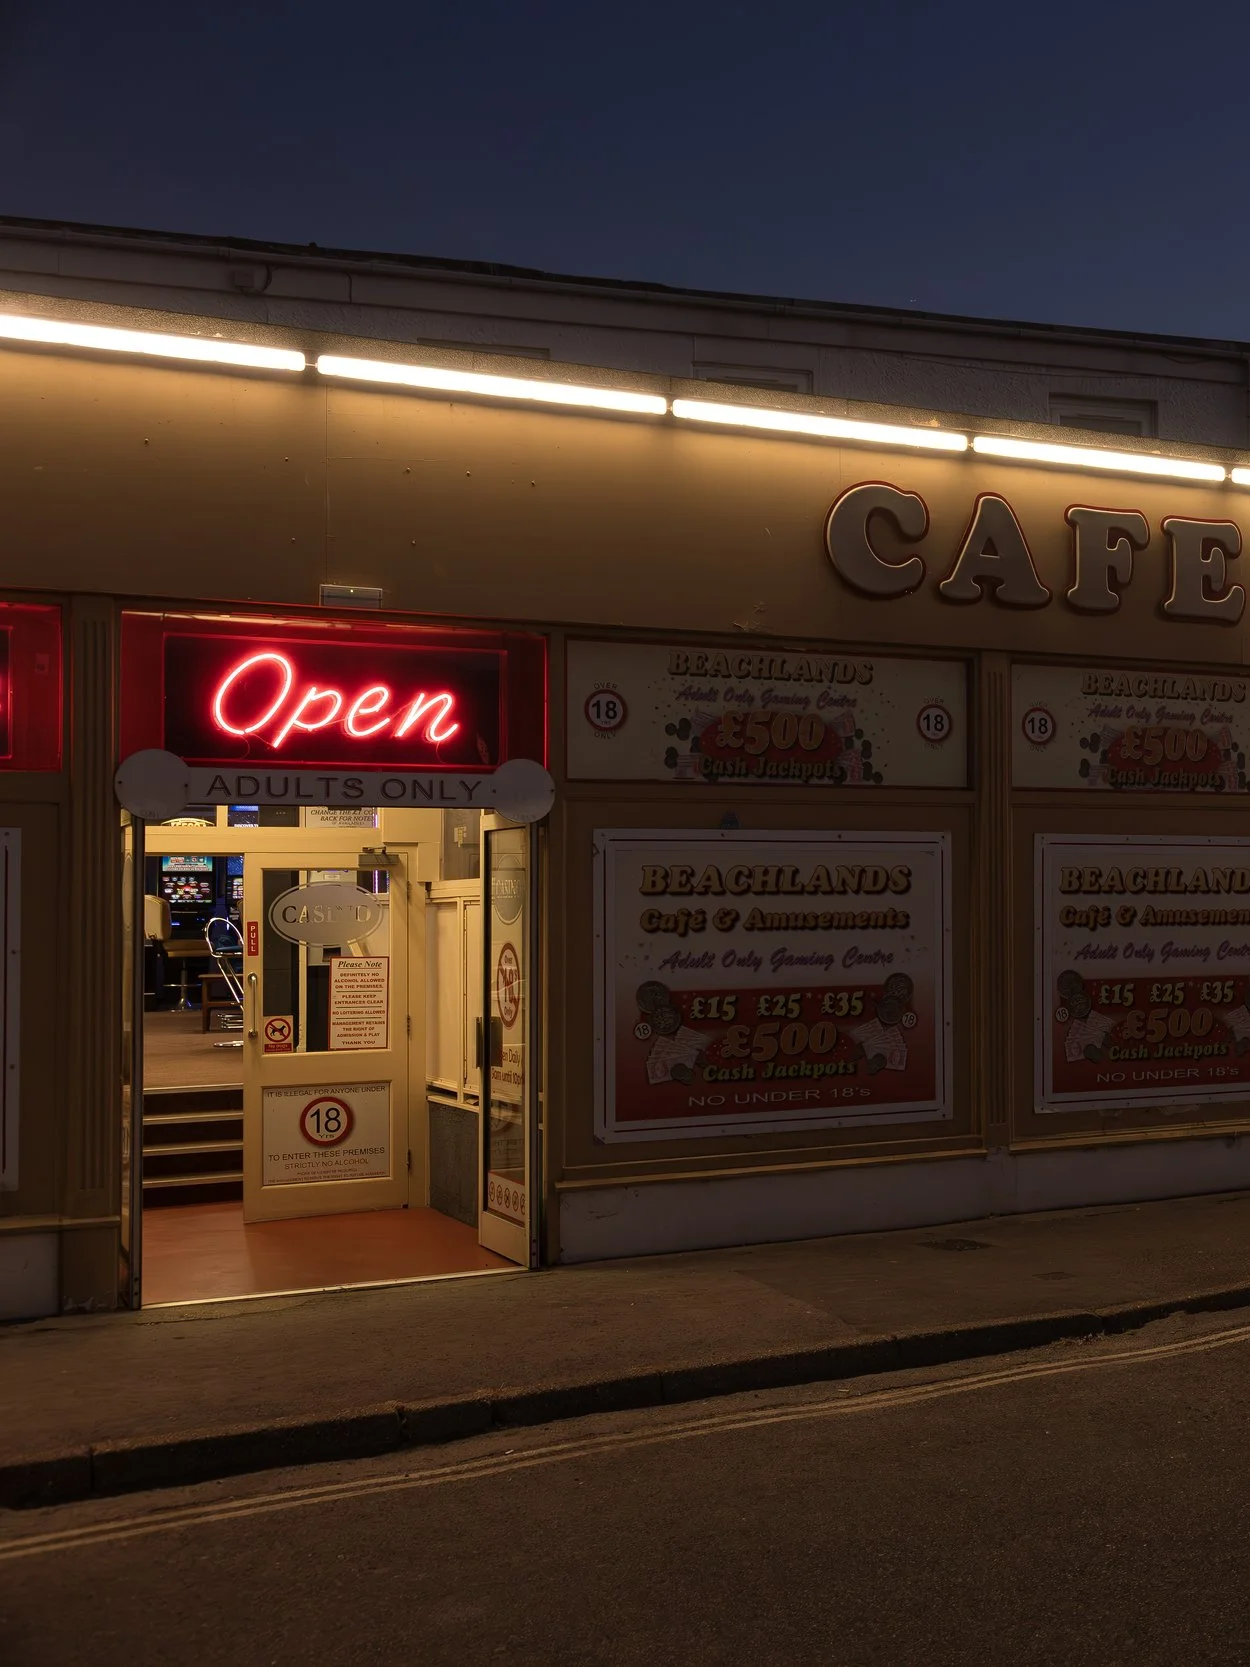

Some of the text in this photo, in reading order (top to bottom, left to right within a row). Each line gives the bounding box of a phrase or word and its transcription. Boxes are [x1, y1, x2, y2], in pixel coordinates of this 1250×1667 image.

[823, 480, 1246, 627] CAFE
[668, 650, 873, 685] BEACHLANDS
[593, 681, 618, 691] OVER
[723, 687, 754, 708] Only
[760, 688, 810, 709] Gaming
[1082, 672, 1247, 703] BEACHLANDS
[212, 651, 460, 749] Open
[591, 700, 618, 720] 18
[716, 710, 826, 756] £500
[923, 714, 944, 732] 18
[1028, 717, 1048, 735] 18
[1120, 726, 1208, 766] £500
[700, 756, 844, 783] Cash Jackpots
[1107, 767, 1223, 792] Cash Jackpots
[206, 774, 483, 802] ADULTS ONLY
[639, 865, 912, 896] BEACHLANDS
[640, 907, 911, 937] Café & Amusements
[1059, 905, 1112, 931] Café
[1115, 905, 1137, 927] &
[658, 946, 895, 973] Adult Only Gaming Centre
[1074, 943, 1118, 961] Adult
[1123, 941, 1155, 963] Only
[1160, 940, 1211, 963] Gaming
[337, 960, 382, 968] Please Note
[1098, 979, 1236, 1008] £15 £25 £35
[689, 990, 866, 1022] £15 £25 £35
[1057, 1008, 1068, 1021] 18
[636, 1024, 649, 1037] 18
[903, 1013, 915, 1026] 18
[1121, 1007, 1215, 1043] £500
[720, 1020, 839, 1062] £500
[1108, 1041, 1229, 1062] Cash Jackpots
[509, 1048, 521, 1067] Daily
[702, 1059, 858, 1083] Cash Jackpots
[1096, 1065, 1240, 1083] NO UNDER 18's
[314, 1088, 329, 1096] FOR
[330, 1086, 359, 1095] ANYONE
[361, 1085, 386, 1093] UNDER
[689, 1086, 873, 1107] NO UNDER 18's
[310, 1107, 342, 1134] 18
[268, 1147, 385, 1162] TO ENTER THESE PREMISES
[284, 1158, 369, 1170] STRICTLY NO ALCOHOL
